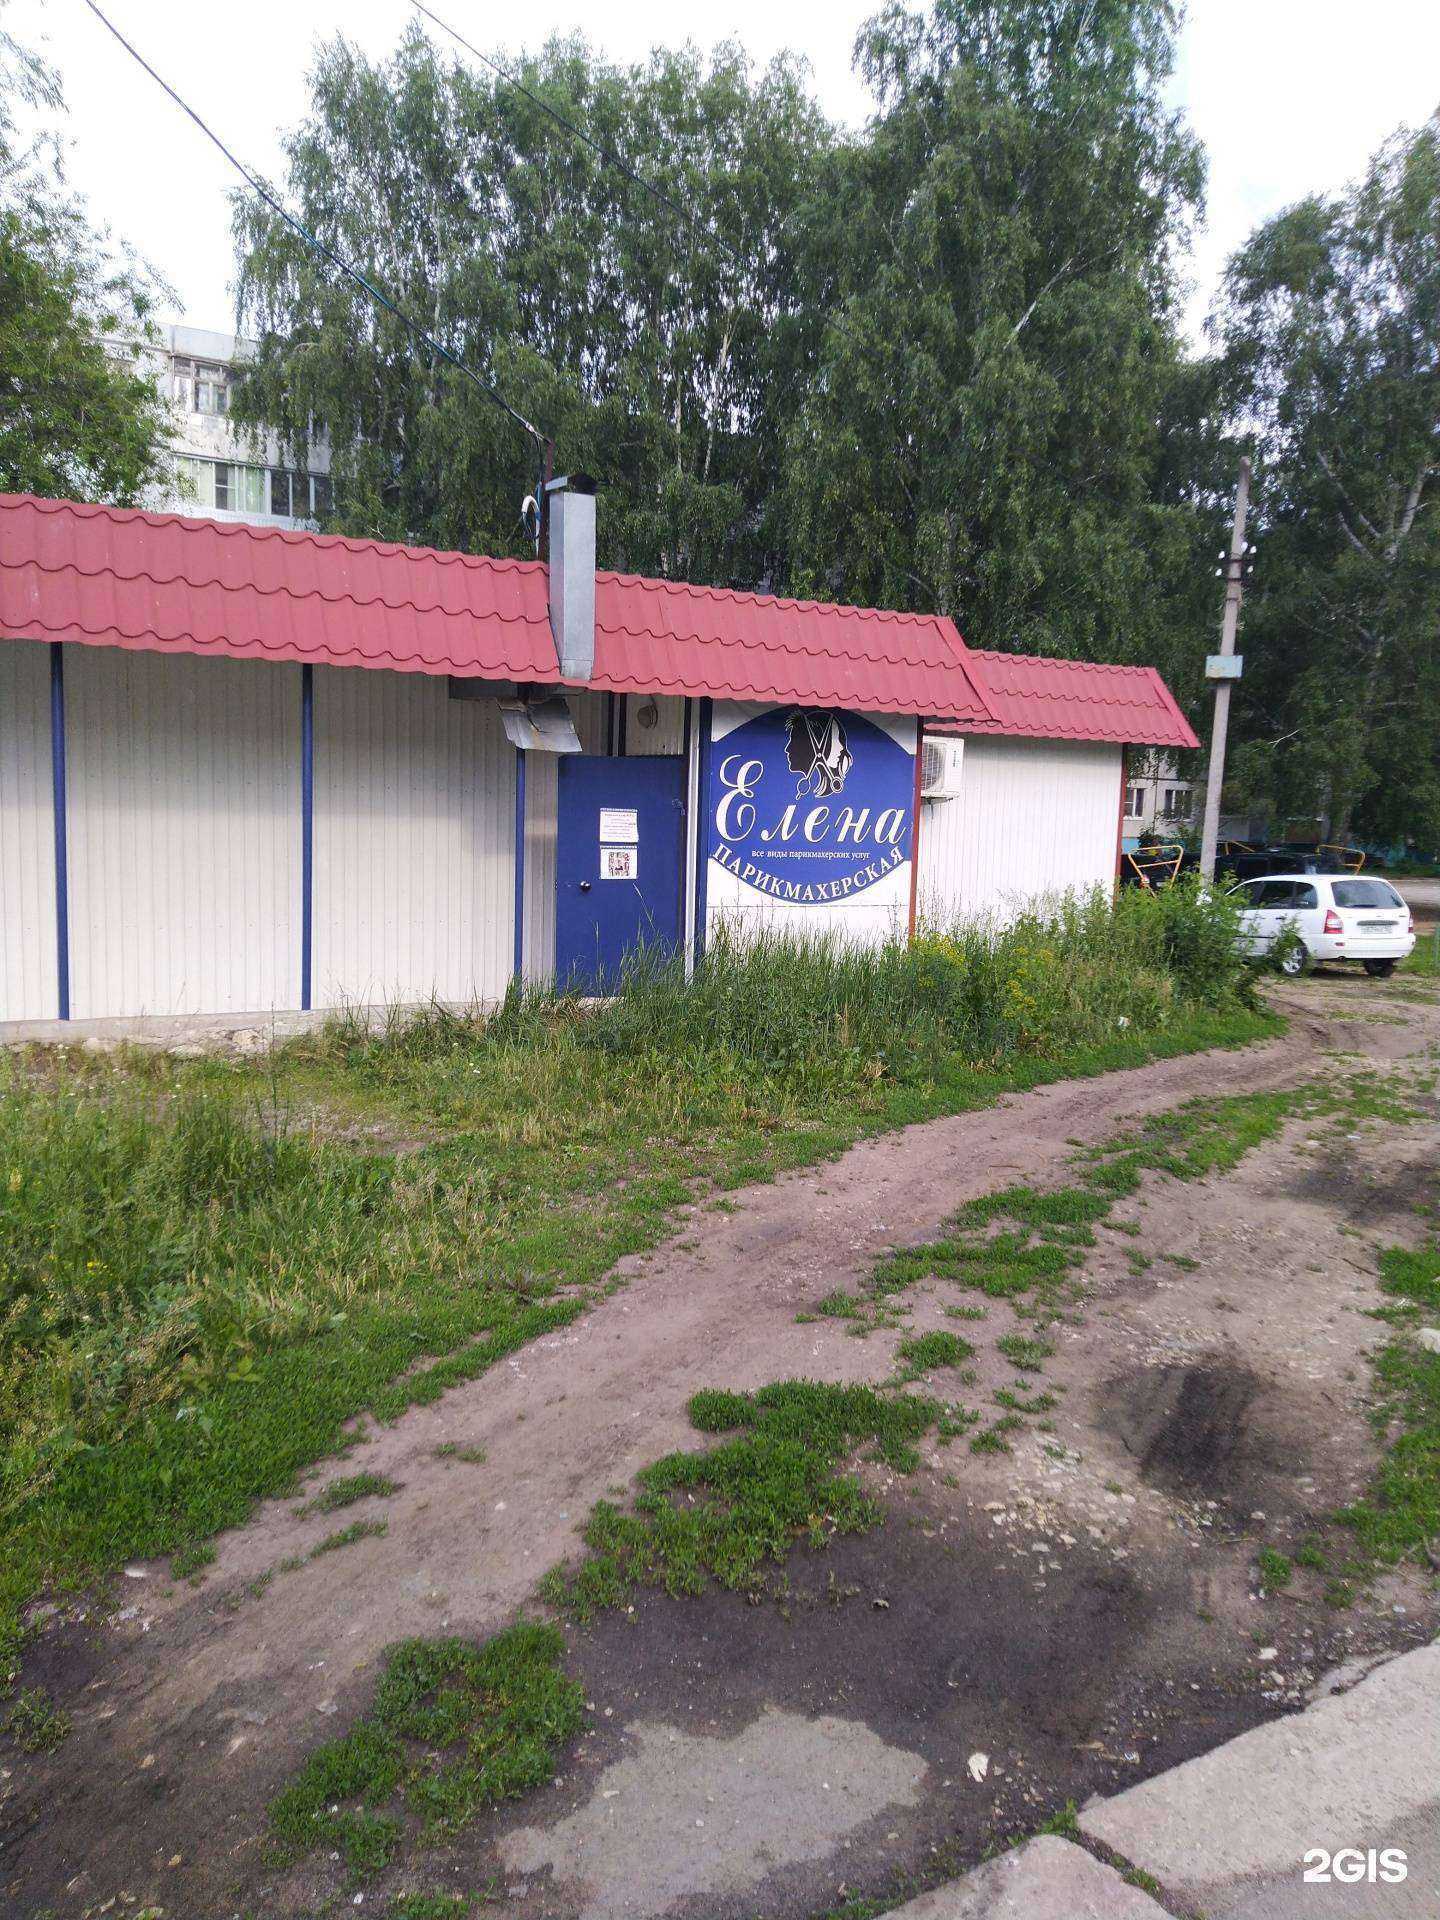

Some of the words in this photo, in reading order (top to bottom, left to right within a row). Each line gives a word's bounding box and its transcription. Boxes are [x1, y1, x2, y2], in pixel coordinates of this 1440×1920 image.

[716, 754, 906, 844] Елена
[712, 843, 905, 901] ПАРИКМАХЕРСКАЯ
[767, 850, 788, 859] виды
[789, 850, 850, 860] парикмахерских
[851, 851, 870, 861] услуг
